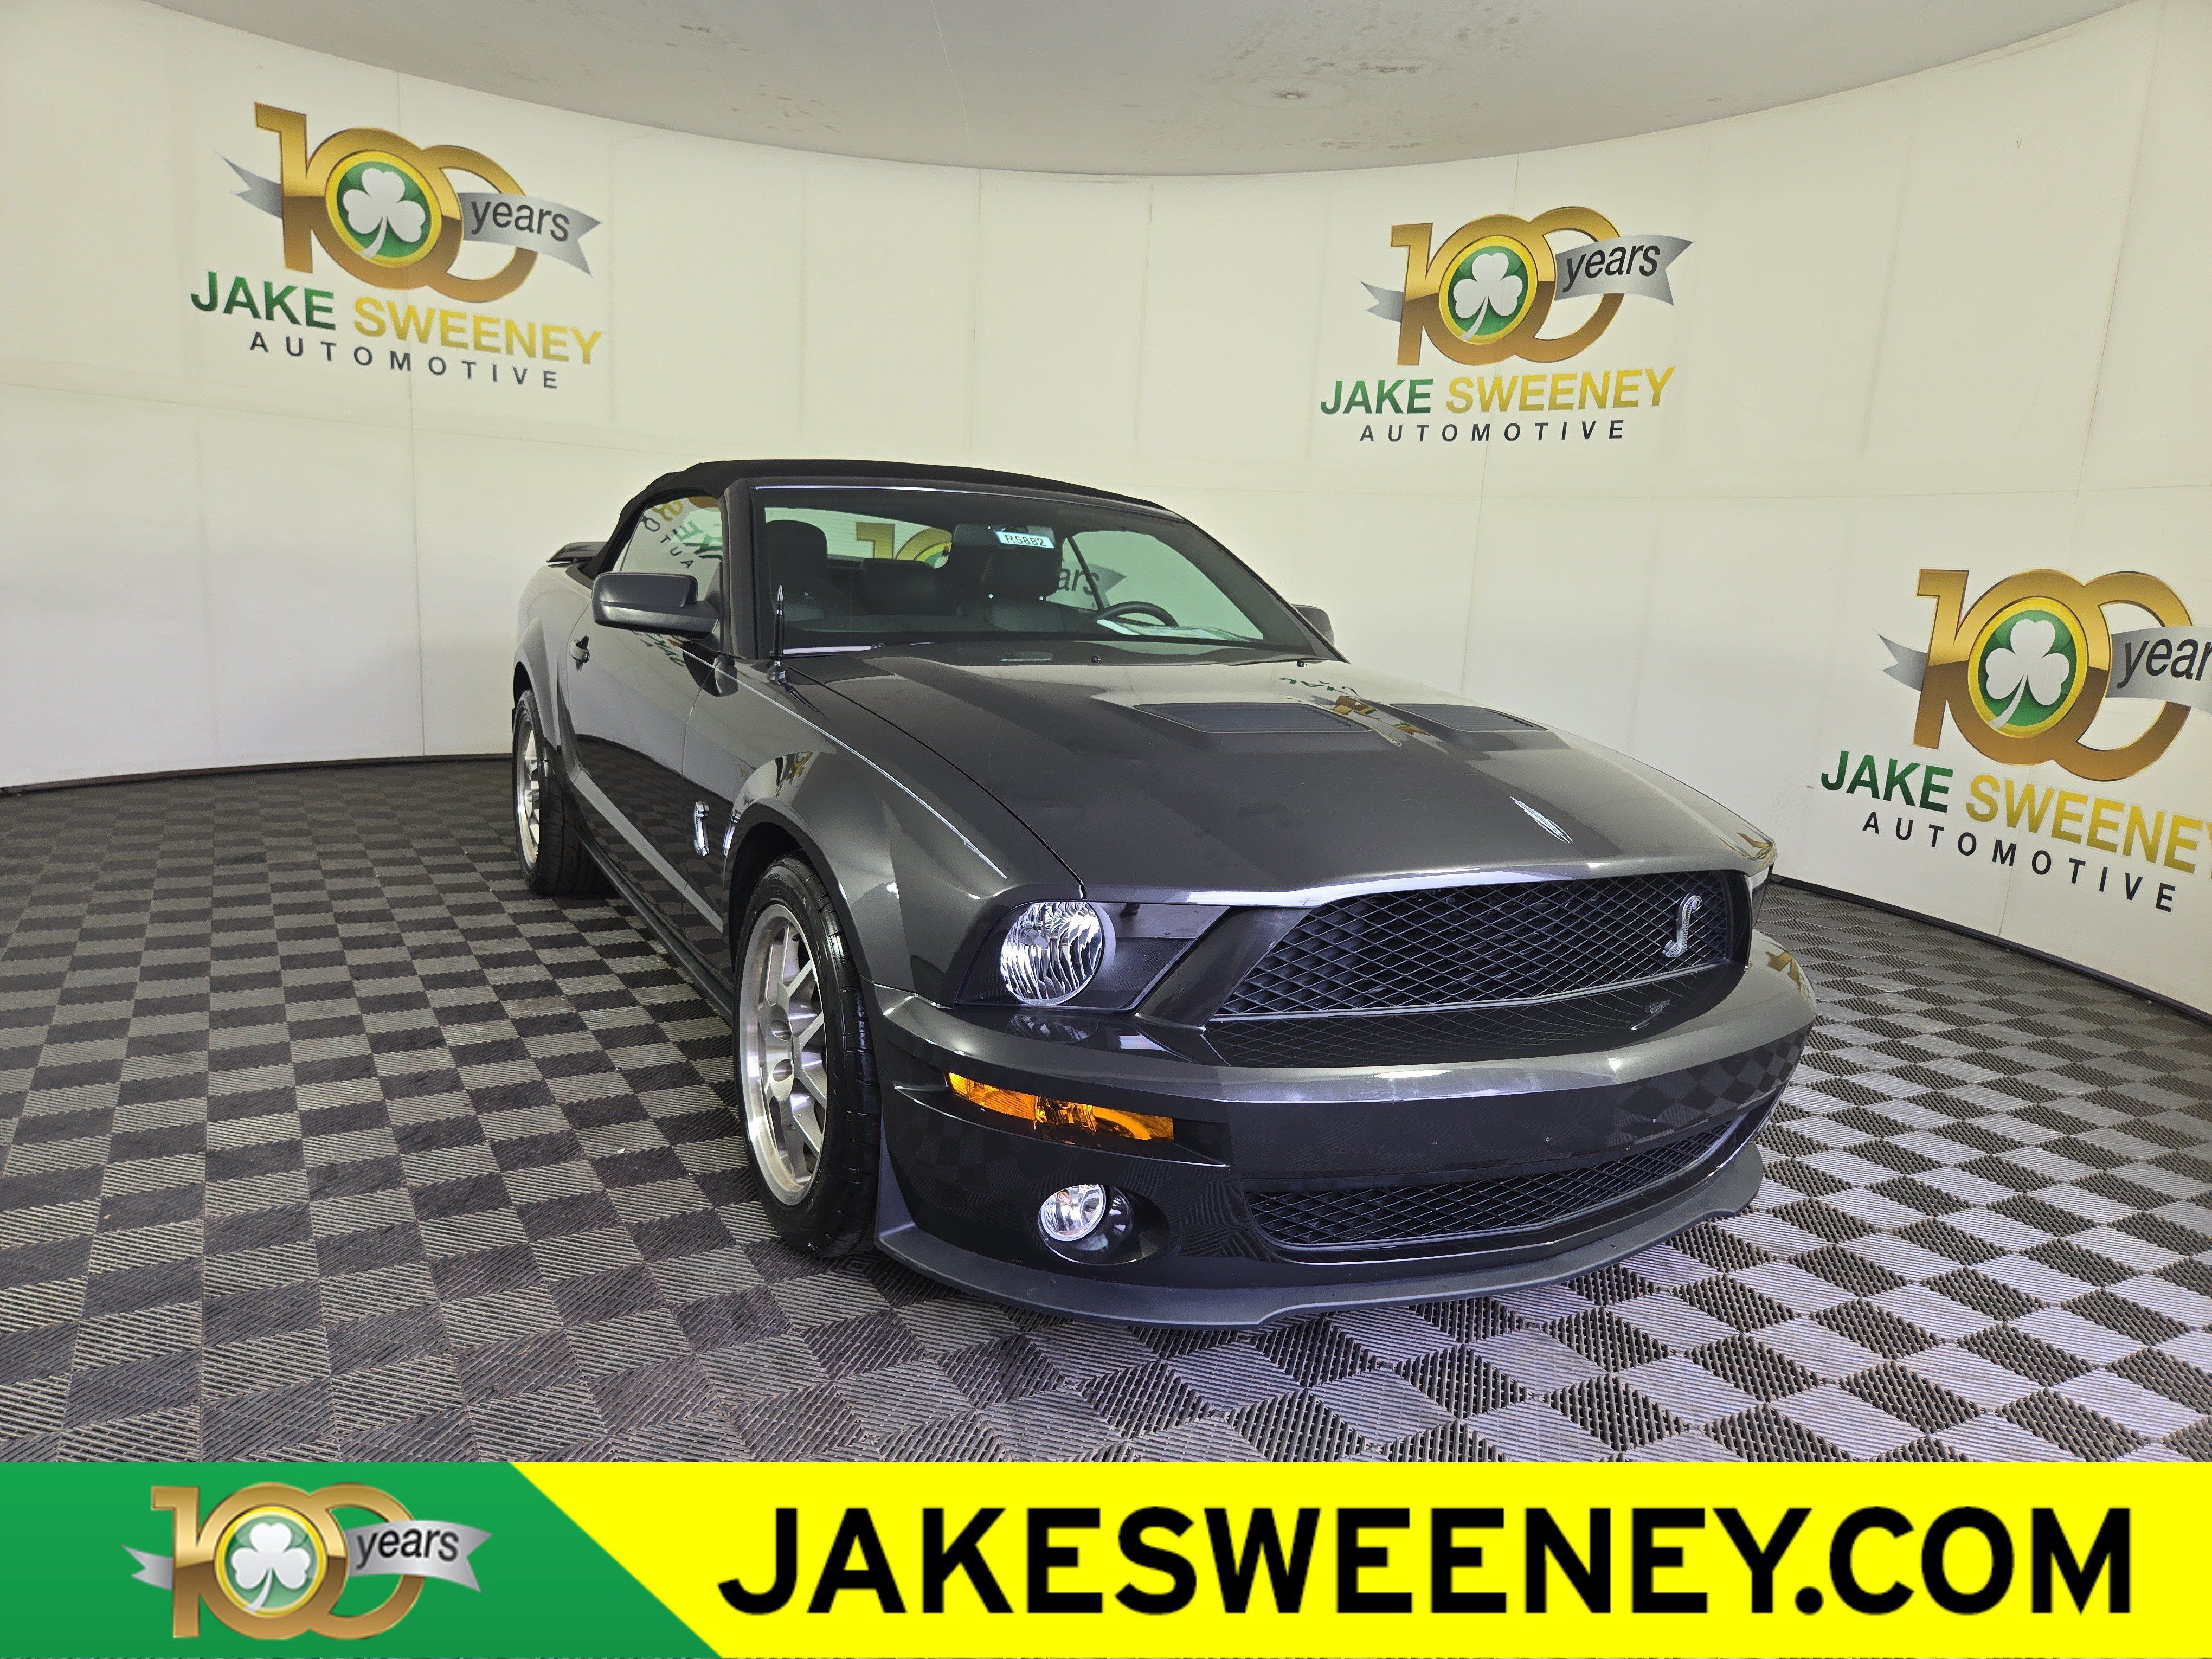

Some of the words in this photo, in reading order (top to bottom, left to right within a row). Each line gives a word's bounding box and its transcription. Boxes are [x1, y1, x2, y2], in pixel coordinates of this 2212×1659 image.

[254, 101, 538, 303] 100
[470, 200, 570, 242] years
[191, 271, 336, 331] JAKE
[353, 297, 602, 364] SWEENEY
[1390, 206, 1624, 366] 100
[1562, 243, 1660, 293] years
[250, 331, 557, 389] AUTOMOTIVE
[1320, 378, 1434, 415] JAKE
[1446, 366, 1676, 413] SWEENEY
[1360, 420, 1624, 443] AUTOMOTIVE
[1005, 535, 1046, 546] R5882
[1912, 568, 2193, 782] 100
[2116, 639, 2212, 689] year
[1821, 750, 1954, 813] JAKE
[1966, 774, 2212, 879] SWEENE
[1862, 812, 2176, 913] AUTOMOTIVE
